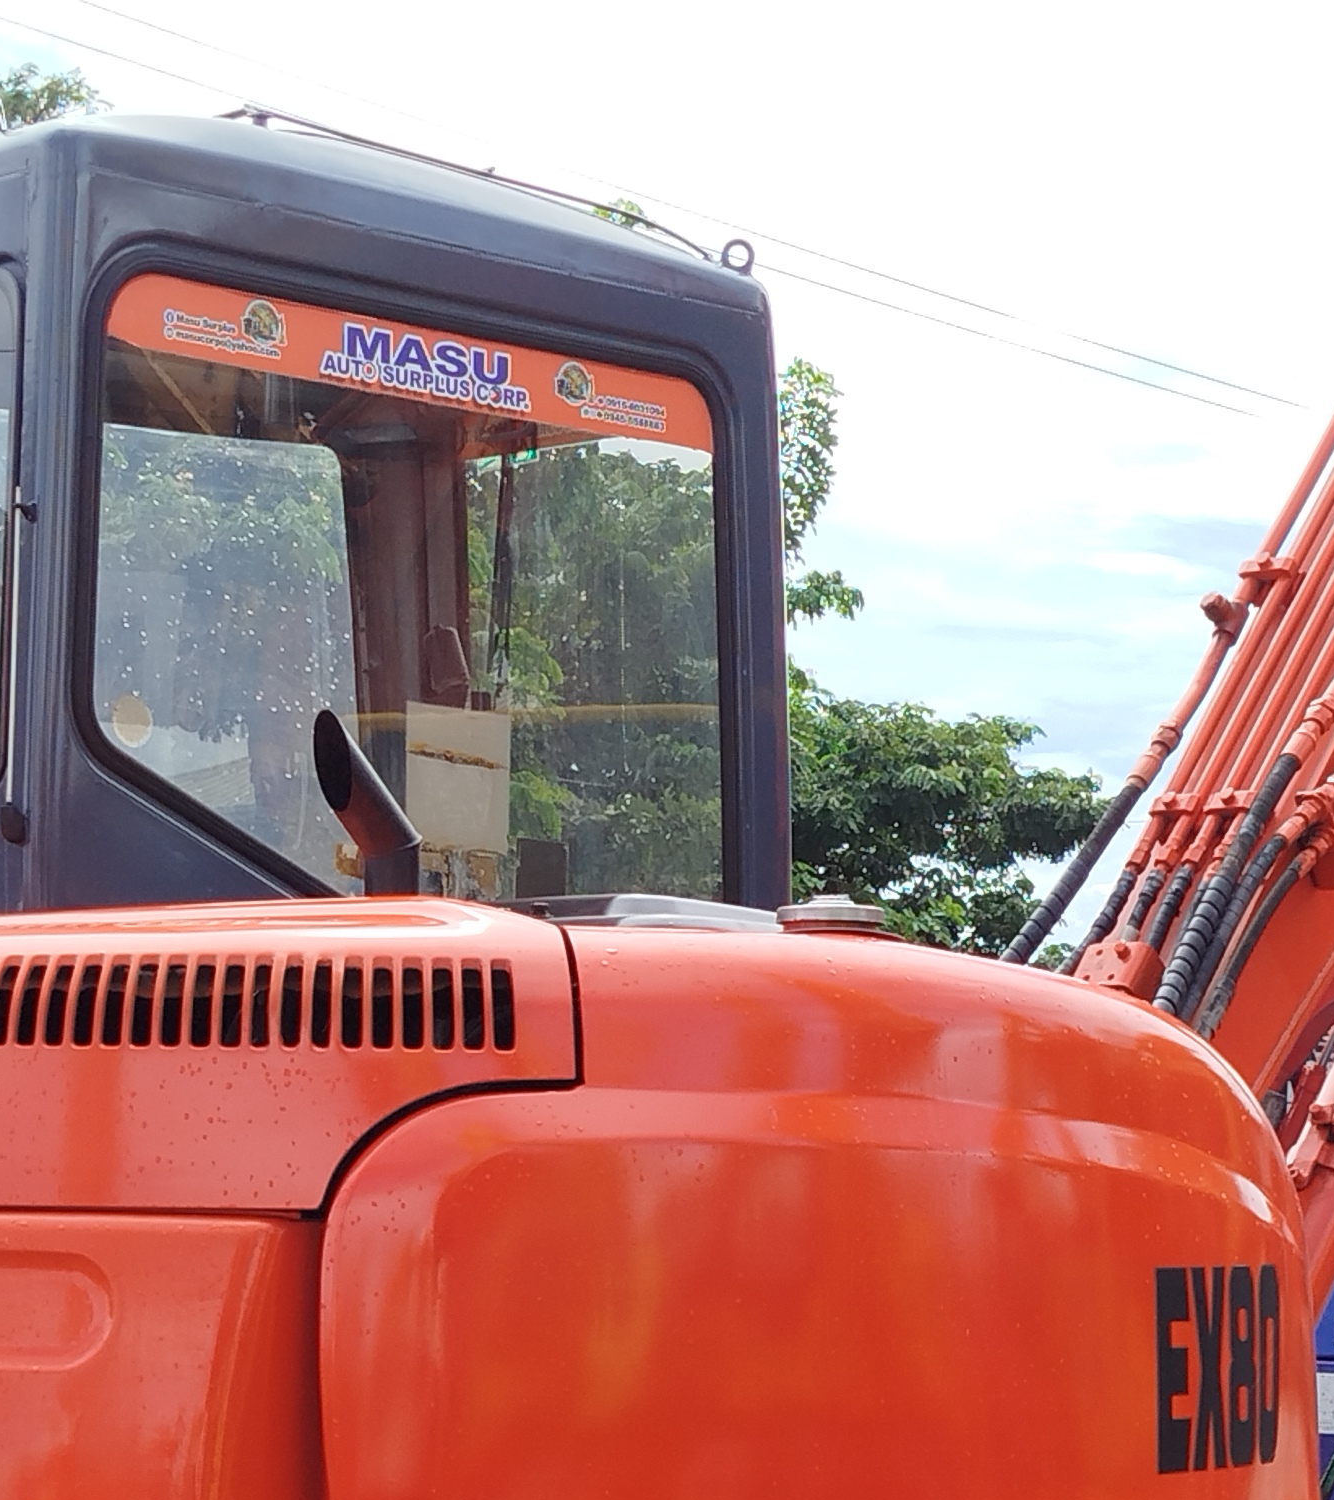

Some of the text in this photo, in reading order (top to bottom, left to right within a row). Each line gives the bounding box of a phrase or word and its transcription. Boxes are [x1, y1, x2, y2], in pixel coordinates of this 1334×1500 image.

[322, 353, 530, 410] AUTO SURPLUS CORP.
[345, 324, 511, 386] MASU
[1154, 1264, 1280, 1474] EX80
